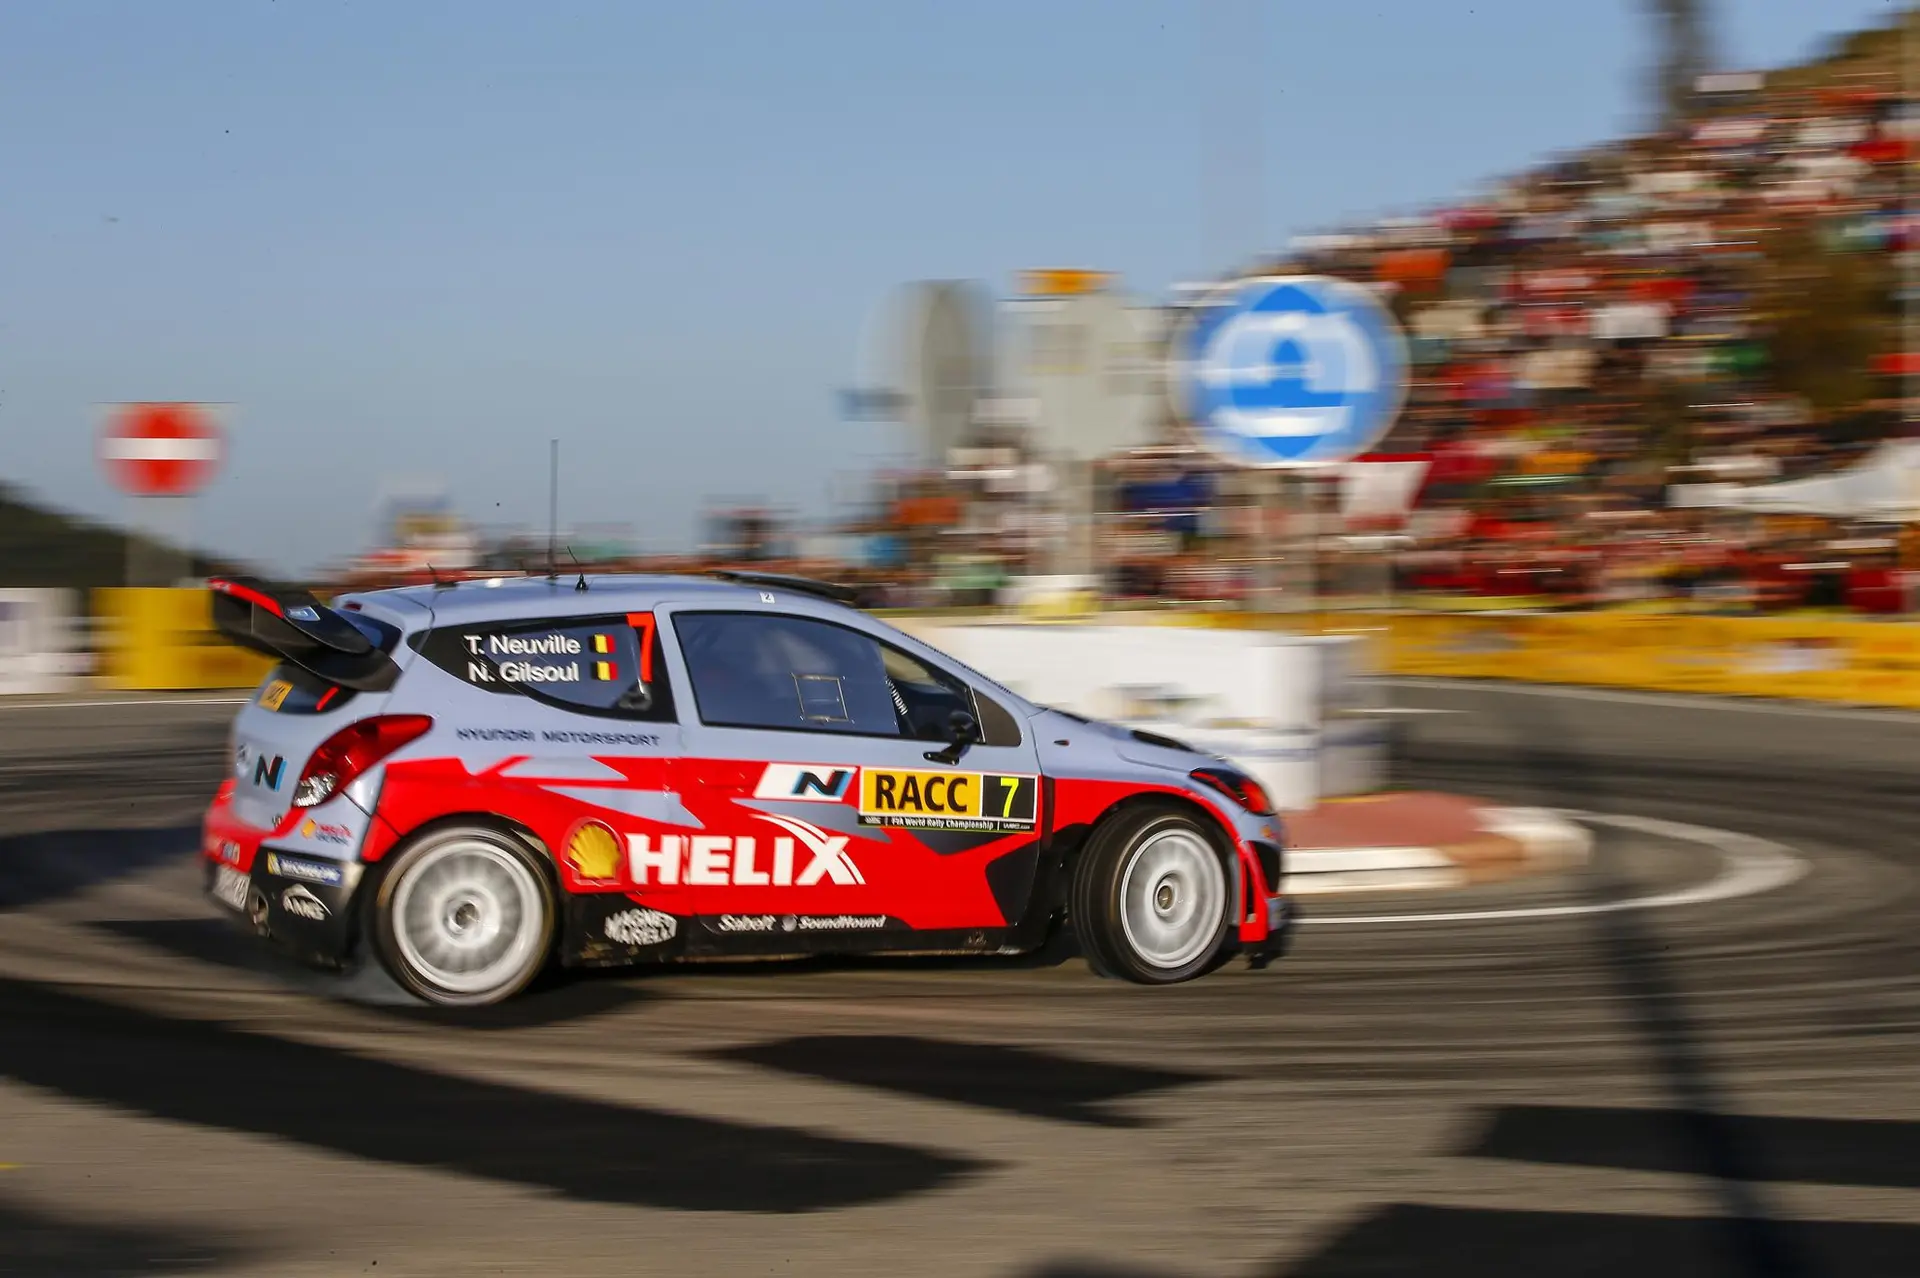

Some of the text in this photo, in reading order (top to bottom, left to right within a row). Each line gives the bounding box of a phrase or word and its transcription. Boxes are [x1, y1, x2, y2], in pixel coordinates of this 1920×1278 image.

[463, 634, 582, 655] T. Neuville
[626, 611, 655, 684] 7
[468, 661, 580, 683] N. Gilsoul
[456, 728, 661, 747] HYUNDAI MOTORSPORT
[792, 769, 852, 797] N
[874, 773, 968, 813] RACC
[1000, 777, 1020, 819] 7
[905, 817, 926, 828] World
[927, 818, 945, 829] Rally
[946, 819, 994, 831] Championship
[624, 830, 867, 886] HELIX
[798, 915, 887, 930] SoundHound
